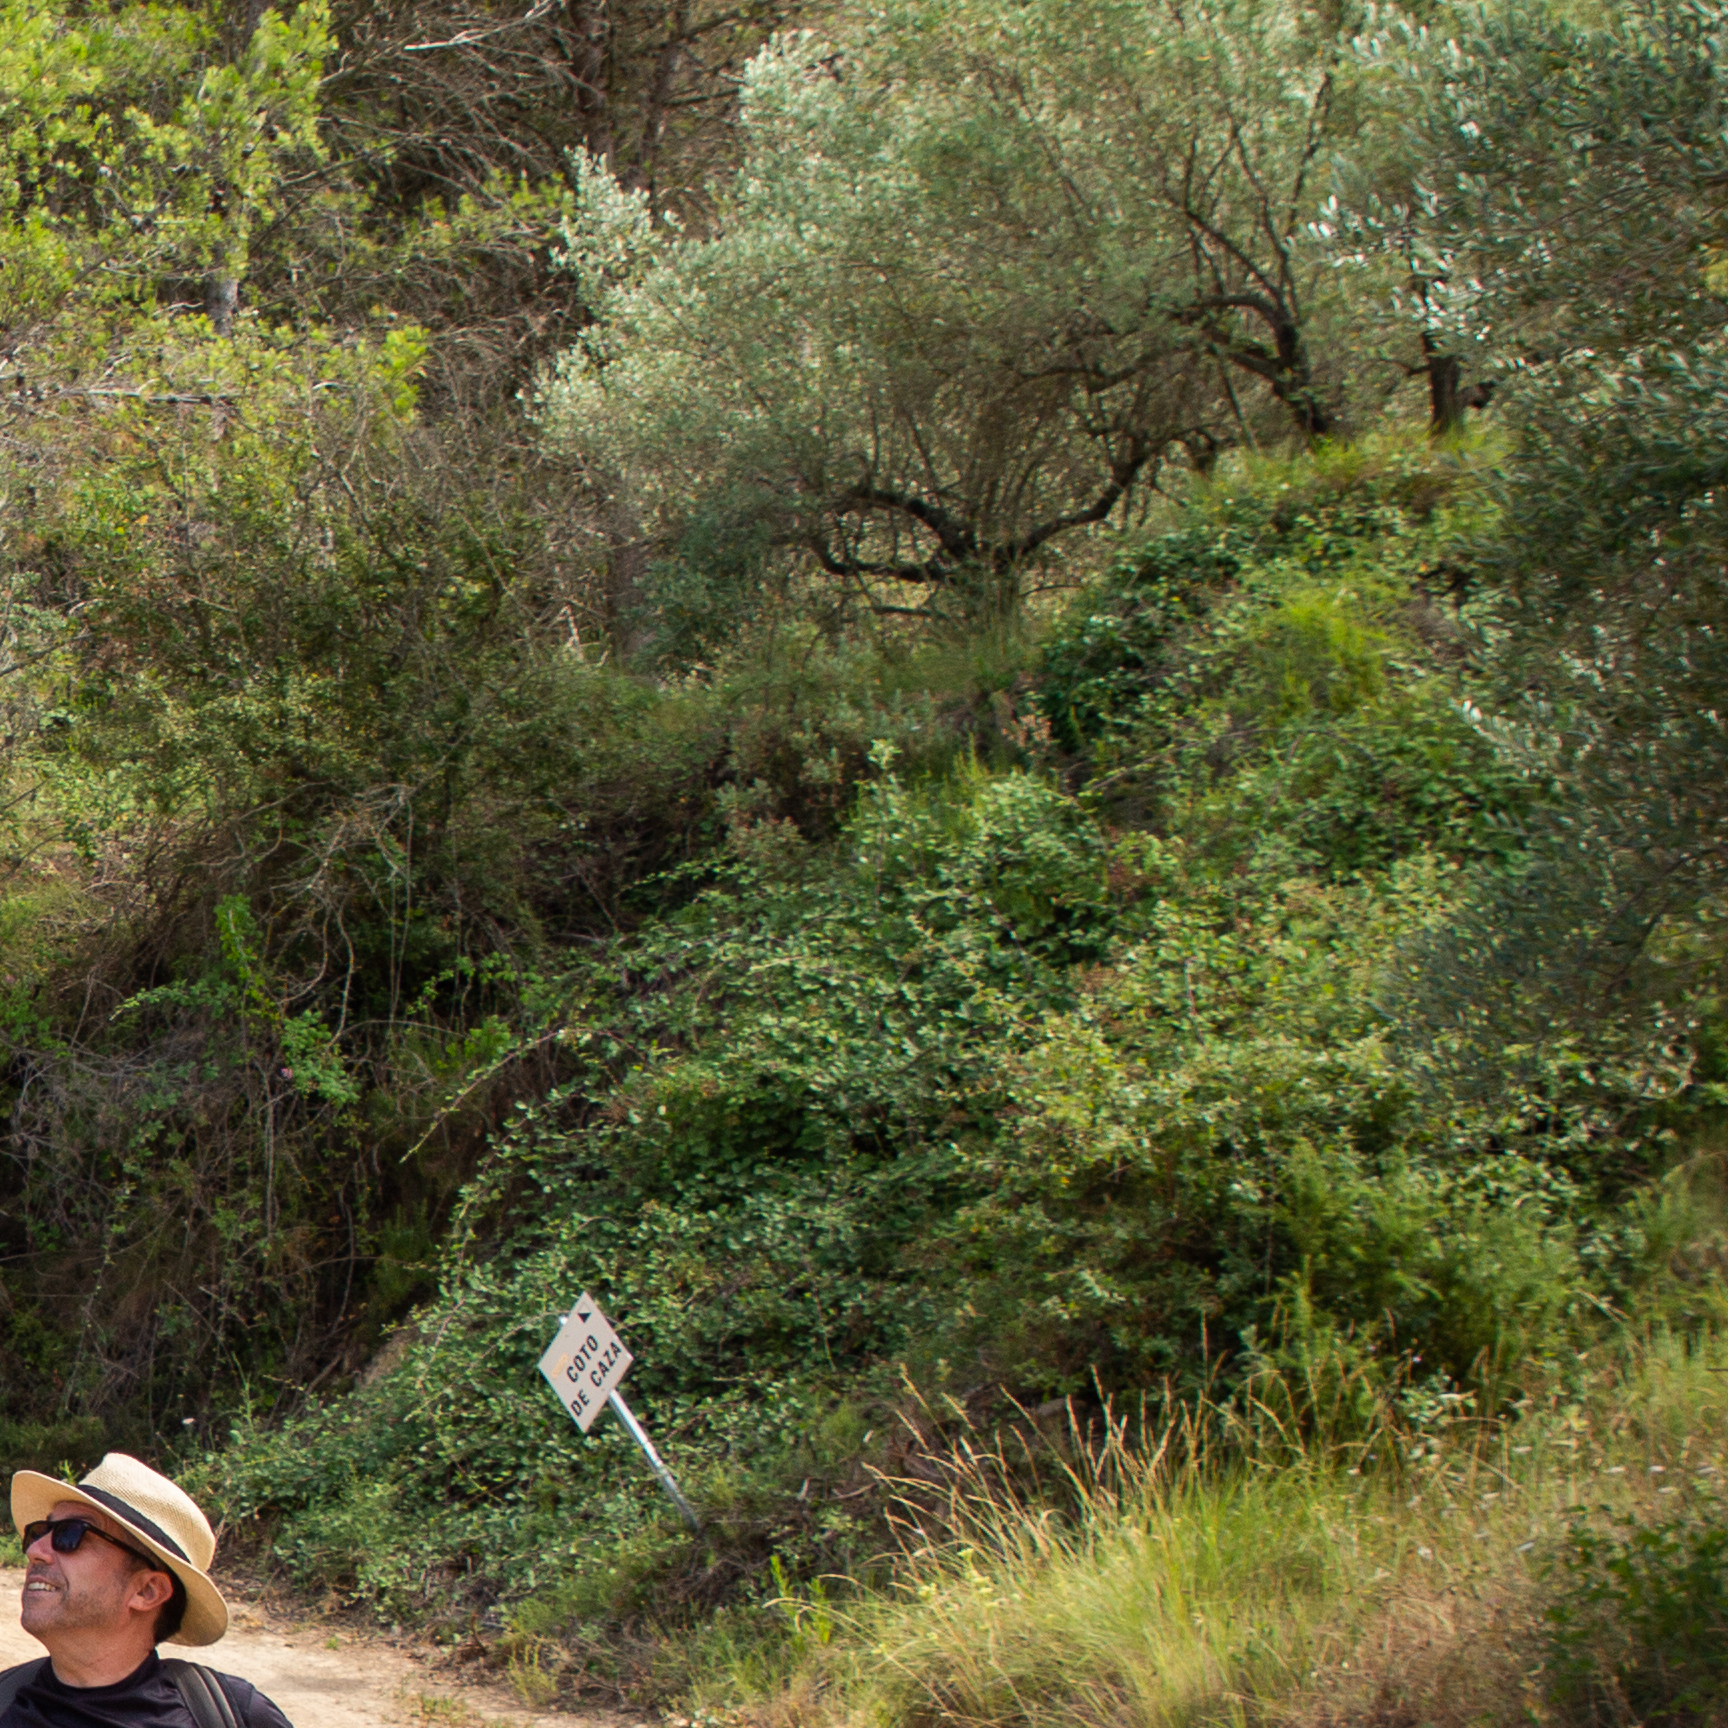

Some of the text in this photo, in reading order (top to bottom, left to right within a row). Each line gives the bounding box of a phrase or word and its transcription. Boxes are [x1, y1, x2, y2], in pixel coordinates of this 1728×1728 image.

[566, 1334, 599, 1383] COTO
[570, 1341, 622, 1417] DE CAZA
